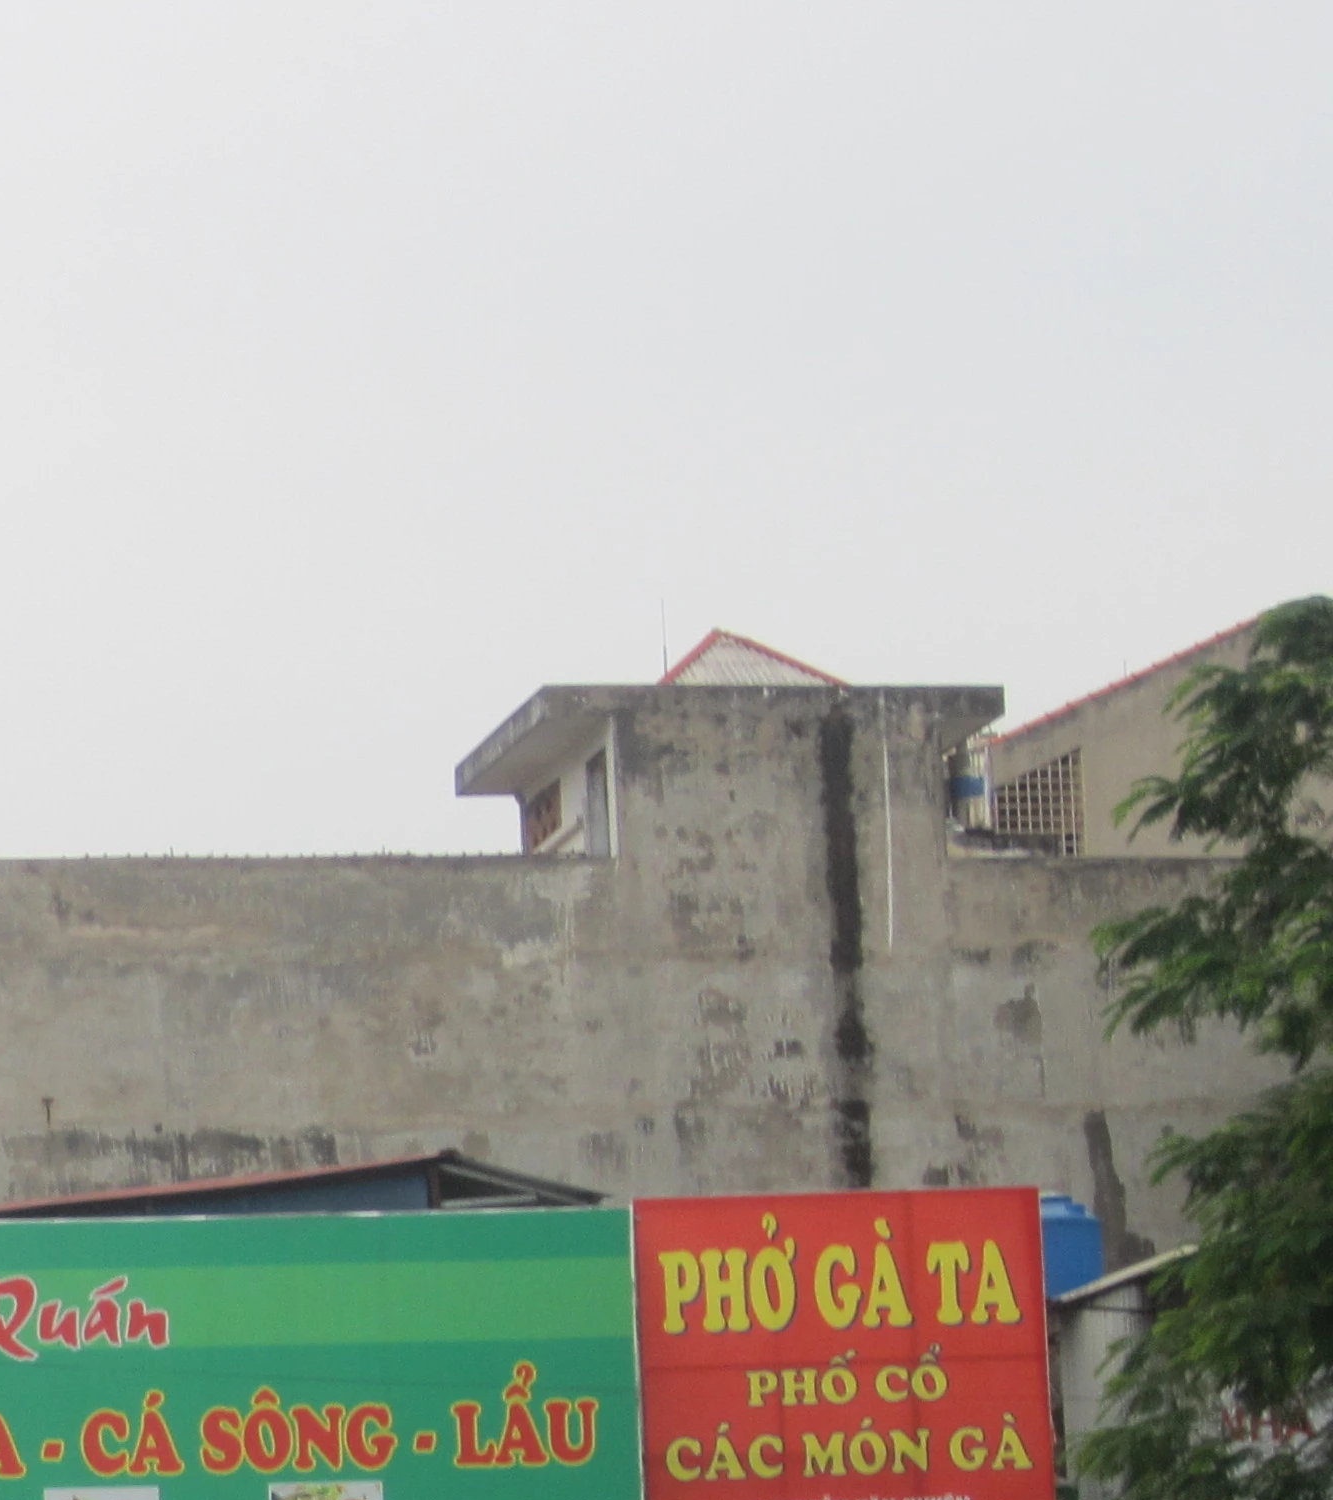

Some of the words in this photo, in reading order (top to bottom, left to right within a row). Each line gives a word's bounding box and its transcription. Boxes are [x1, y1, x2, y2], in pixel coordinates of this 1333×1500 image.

[659, 1212, 796, 1334] PHỞ
[814, 1217, 913, 1329] GÀ
[927, 1239, 1021, 1325] TA
[80, 1390, 183, 1475] CÁ
[201, 1387, 397, 1473] SÔNG
[452, 1360, 598, 1468] LẨU
[747, 1351, 857, 1407] PHỐ
[875, 1343, 947, 1402] CỔ
[666, 1423, 785, 1481] CÁC
[803, 1418, 930, 1477] MÓN
[949, 1412, 1032, 1471] GÀ
